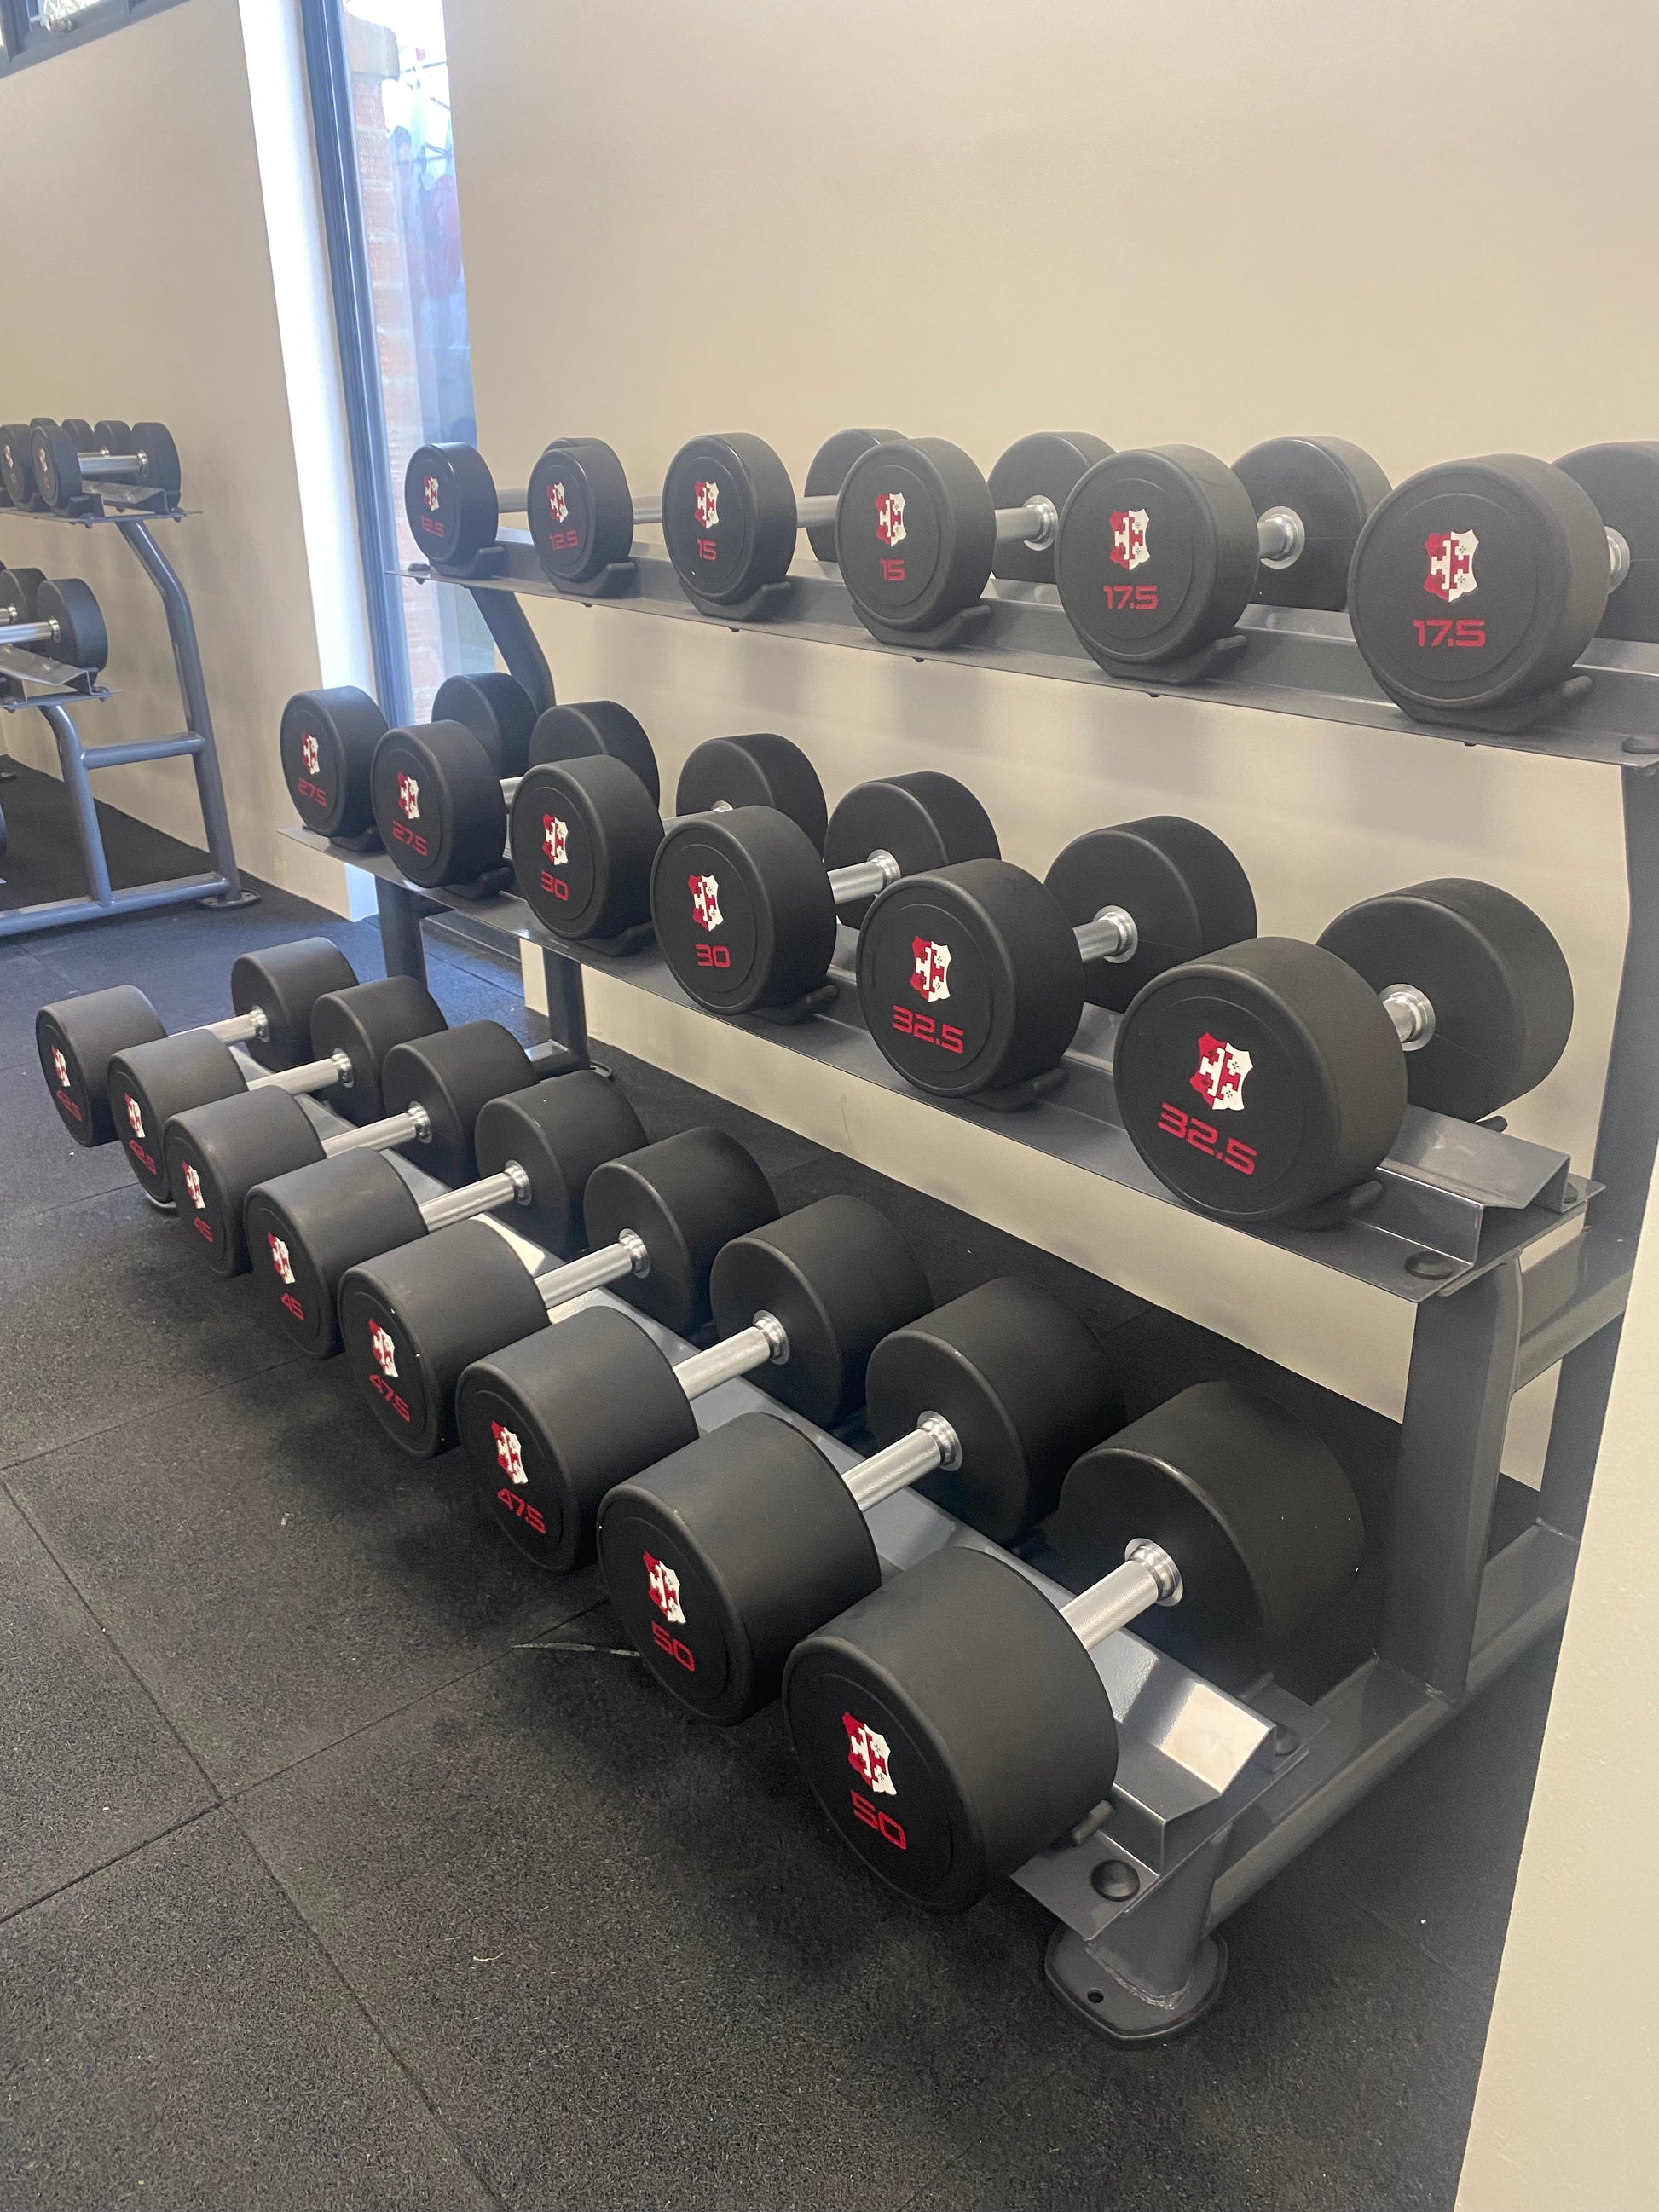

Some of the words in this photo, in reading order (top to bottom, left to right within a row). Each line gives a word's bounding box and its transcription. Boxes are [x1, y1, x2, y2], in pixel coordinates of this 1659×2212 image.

[420, 516, 444, 539] 12.5
[549, 521, 578, 551] 12.5
[697, 540, 717, 560] 15
[880, 559, 905, 581] 15
[1102, 584, 1159, 611] 17.5
[1413, 618, 1486, 648] 17.5
[541, 870, 569, 900] 30
[695, 944, 731, 968] 30
[893, 1005, 965, 1054] 32.5
[1157, 1102, 1257, 1175] 32.5
[280, 1292, 305, 1321] 45
[651, 1621, 697, 1672] 50
[851, 1790, 907, 1851] 50
